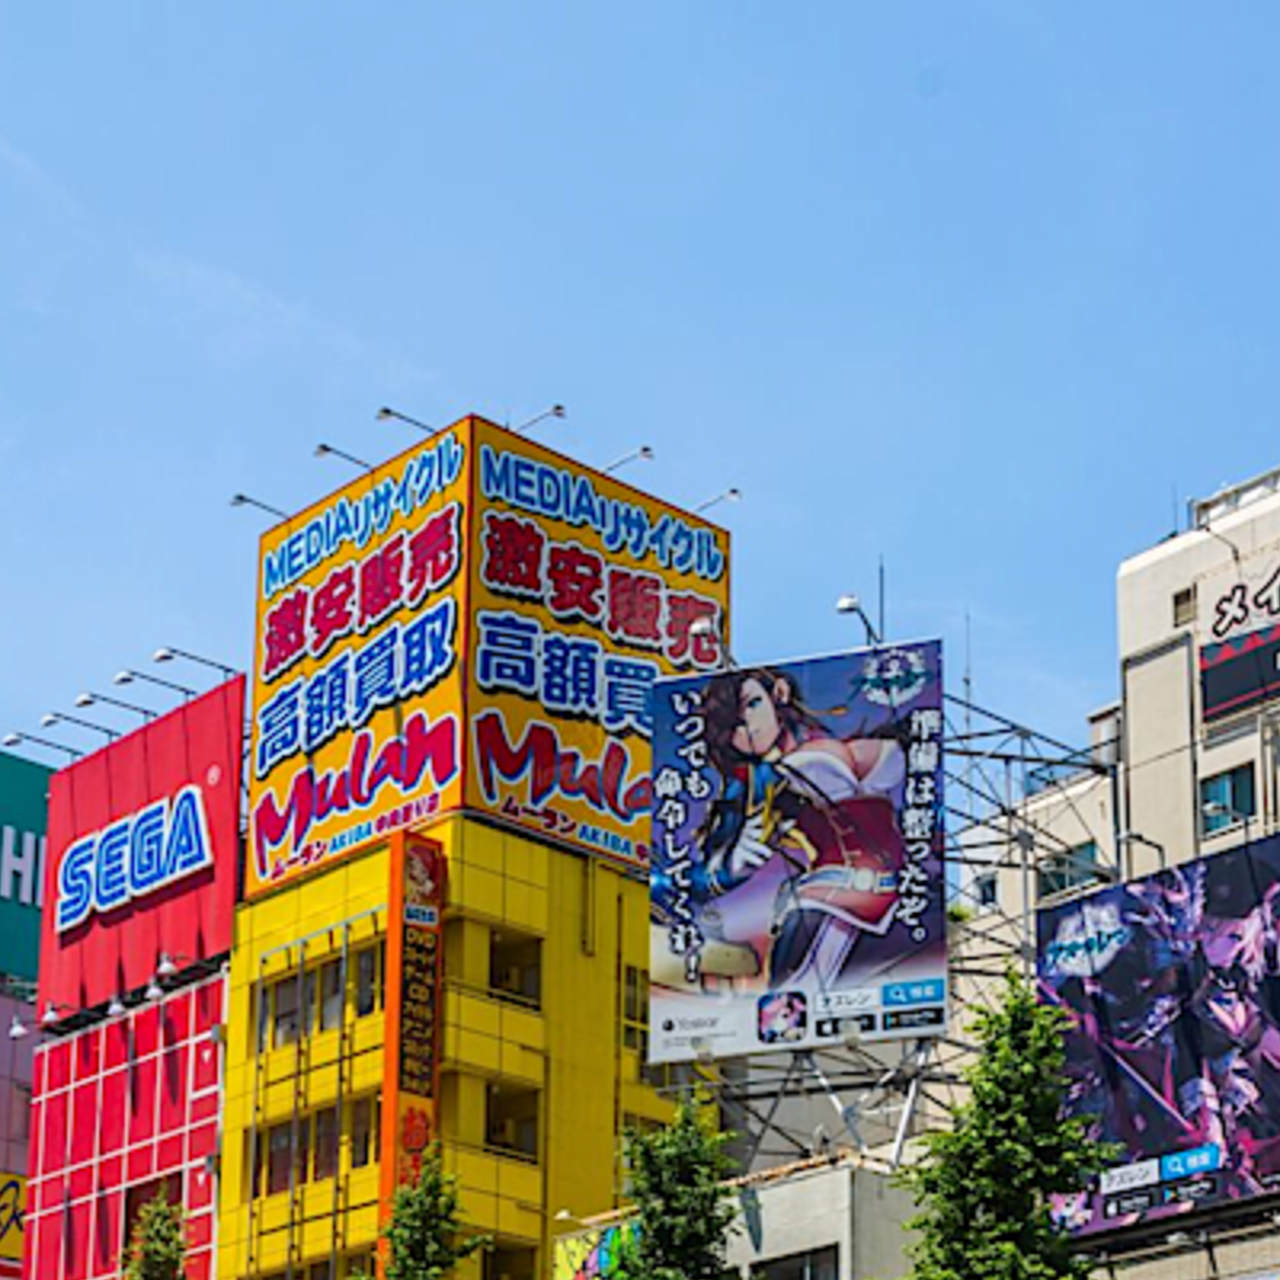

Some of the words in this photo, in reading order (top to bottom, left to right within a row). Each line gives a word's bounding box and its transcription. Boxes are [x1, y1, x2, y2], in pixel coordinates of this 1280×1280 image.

[262, 503, 460, 682] 激安販売
[257, 598, 458, 778] 高額買取
[672, 690, 711, 800] いつでも
[56, 784, 213, 936] SEGA
[896, 708, 942, 942] 準備は整ったぞ。
